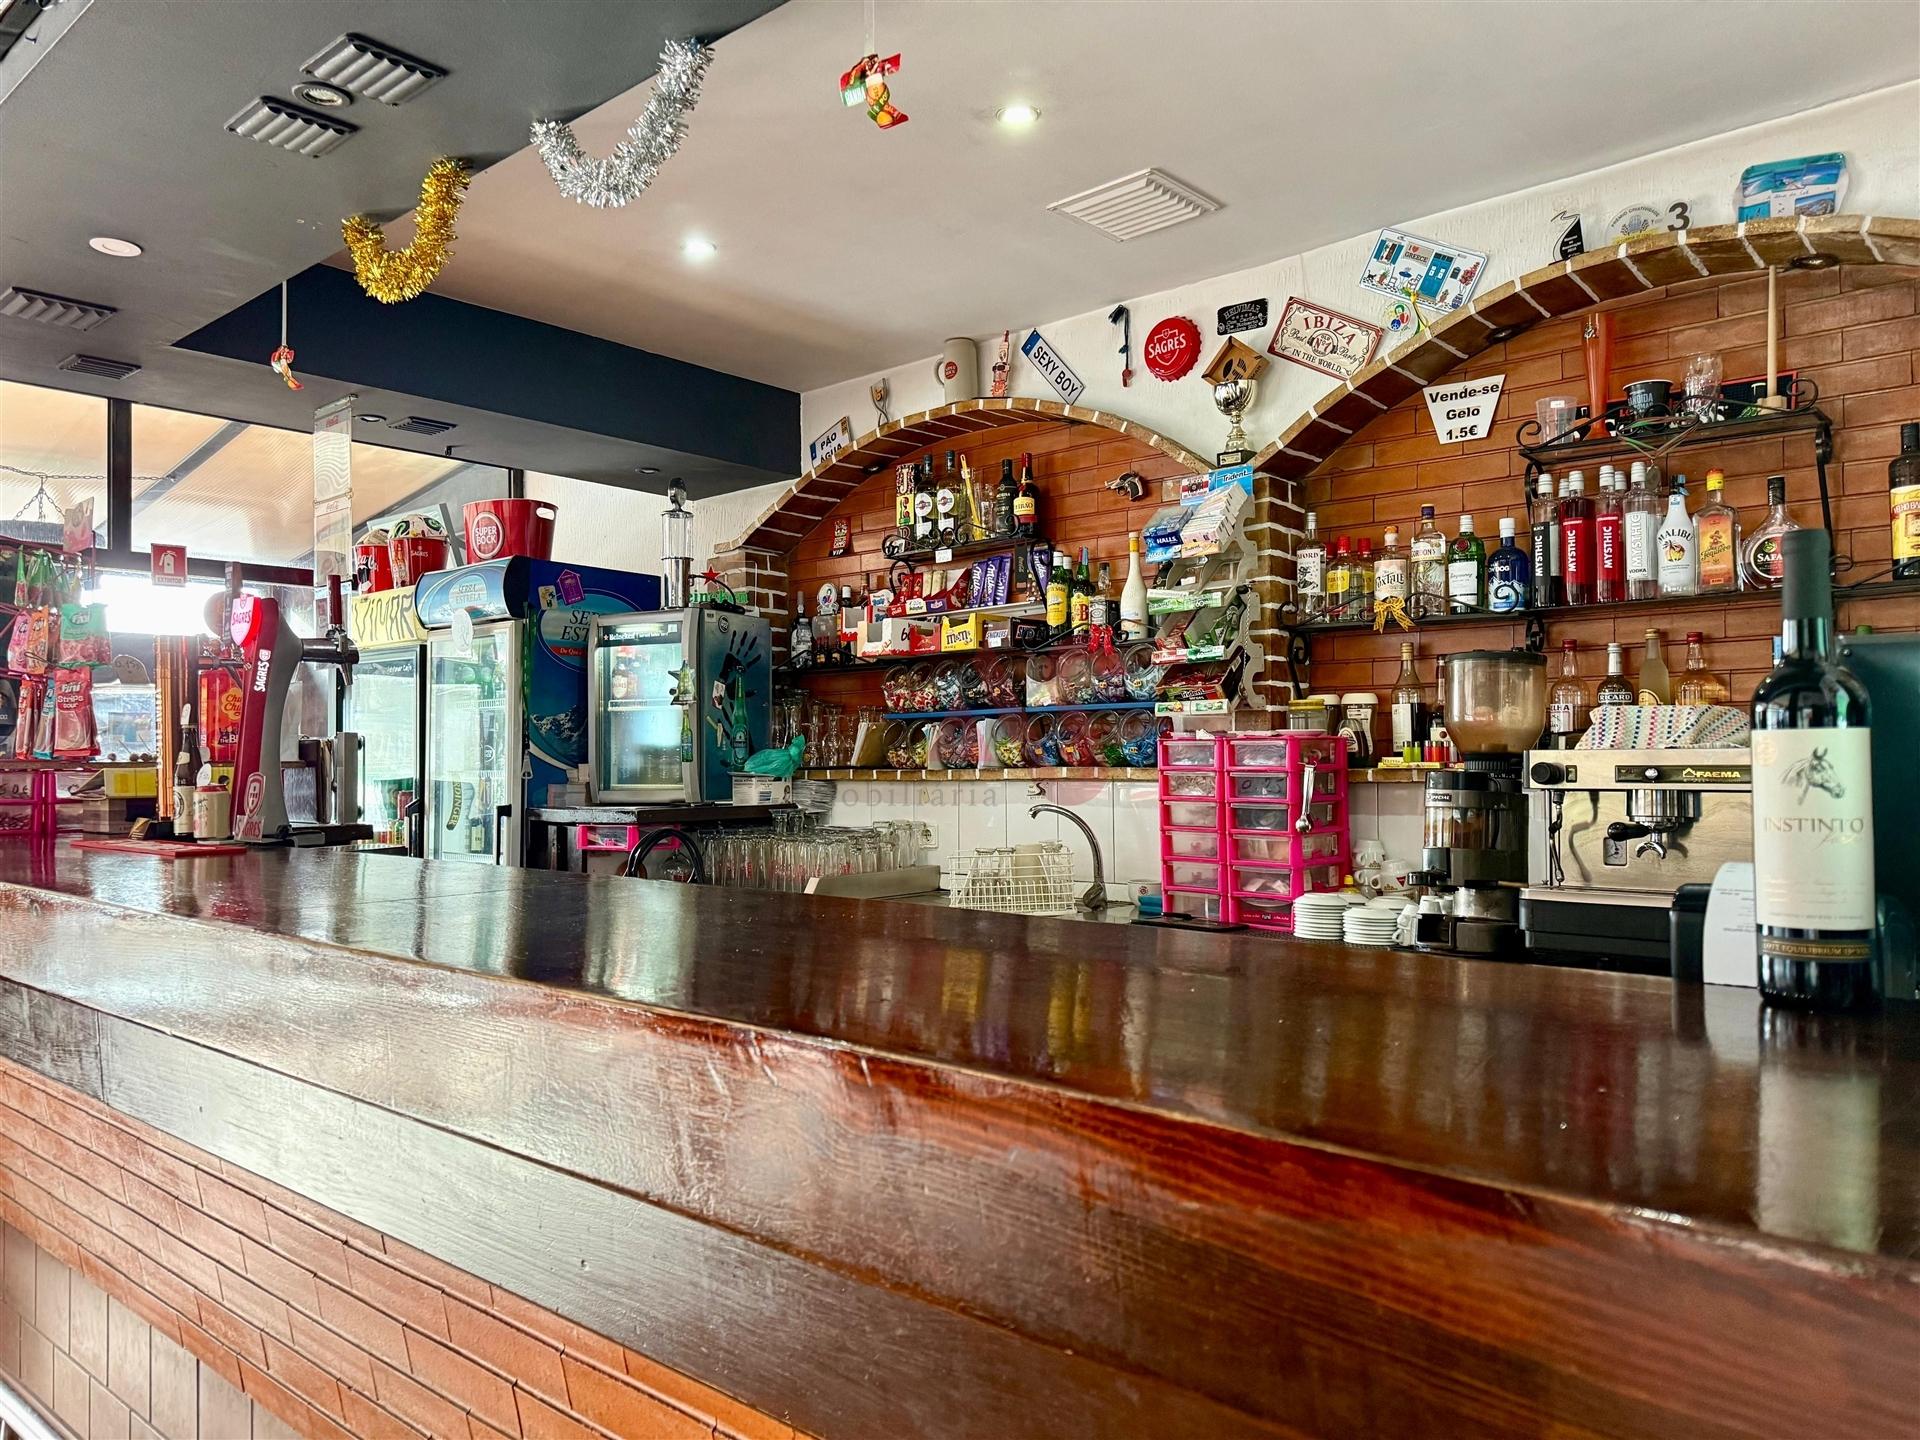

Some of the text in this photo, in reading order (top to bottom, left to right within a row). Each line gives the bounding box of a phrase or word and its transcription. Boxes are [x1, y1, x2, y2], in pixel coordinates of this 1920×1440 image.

[1667, 202, 1690, 231] 3
[1404, 252, 1429, 263] GREECE
[1223, 304, 1261, 320] HELVIMAR
[1304, 315, 1356, 347] IBIZA
[1148, 333, 1187, 359] SAGRES
[1288, 328, 1359, 364] Best Party
[1292, 348, 1301, 357] IN
[1302, 352, 1316, 364] THE
[1033, 345, 1079, 397] SEXY BOY
[1429, 384, 1500, 403] Vende-se
[1446, 407, 1480, 420] Gelo
[820, 432, 837, 450] PÃO
[1446, 425, 1478, 440] 1.5€
[1222, 469, 1249, 482] Trident
[475, 525, 498, 537] SUPER
[1156, 536, 1177, 544] HALLS
[1657, 528, 1694, 545] MALIBU
[477, 535, 497, 546] BOCK
[1602, 526, 1614, 569] MYSTHIC
[1630, 513, 1641, 568] MYSTHIC
[1535, 535, 1544, 577] MYSTHIC
[1567, 529, 1577, 572] MYSTHIC
[972, 564, 982, 598] Milka
[987, 563, 996, 596] Milka
[232, 610, 252, 626] SAGRES
[985, 630, 1008, 640] SNICKERS
[254, 659, 270, 692] SAGRES
[1599, 693, 1631, 701] RICARD
[1763, 816, 1864, 834] INSTINTO
